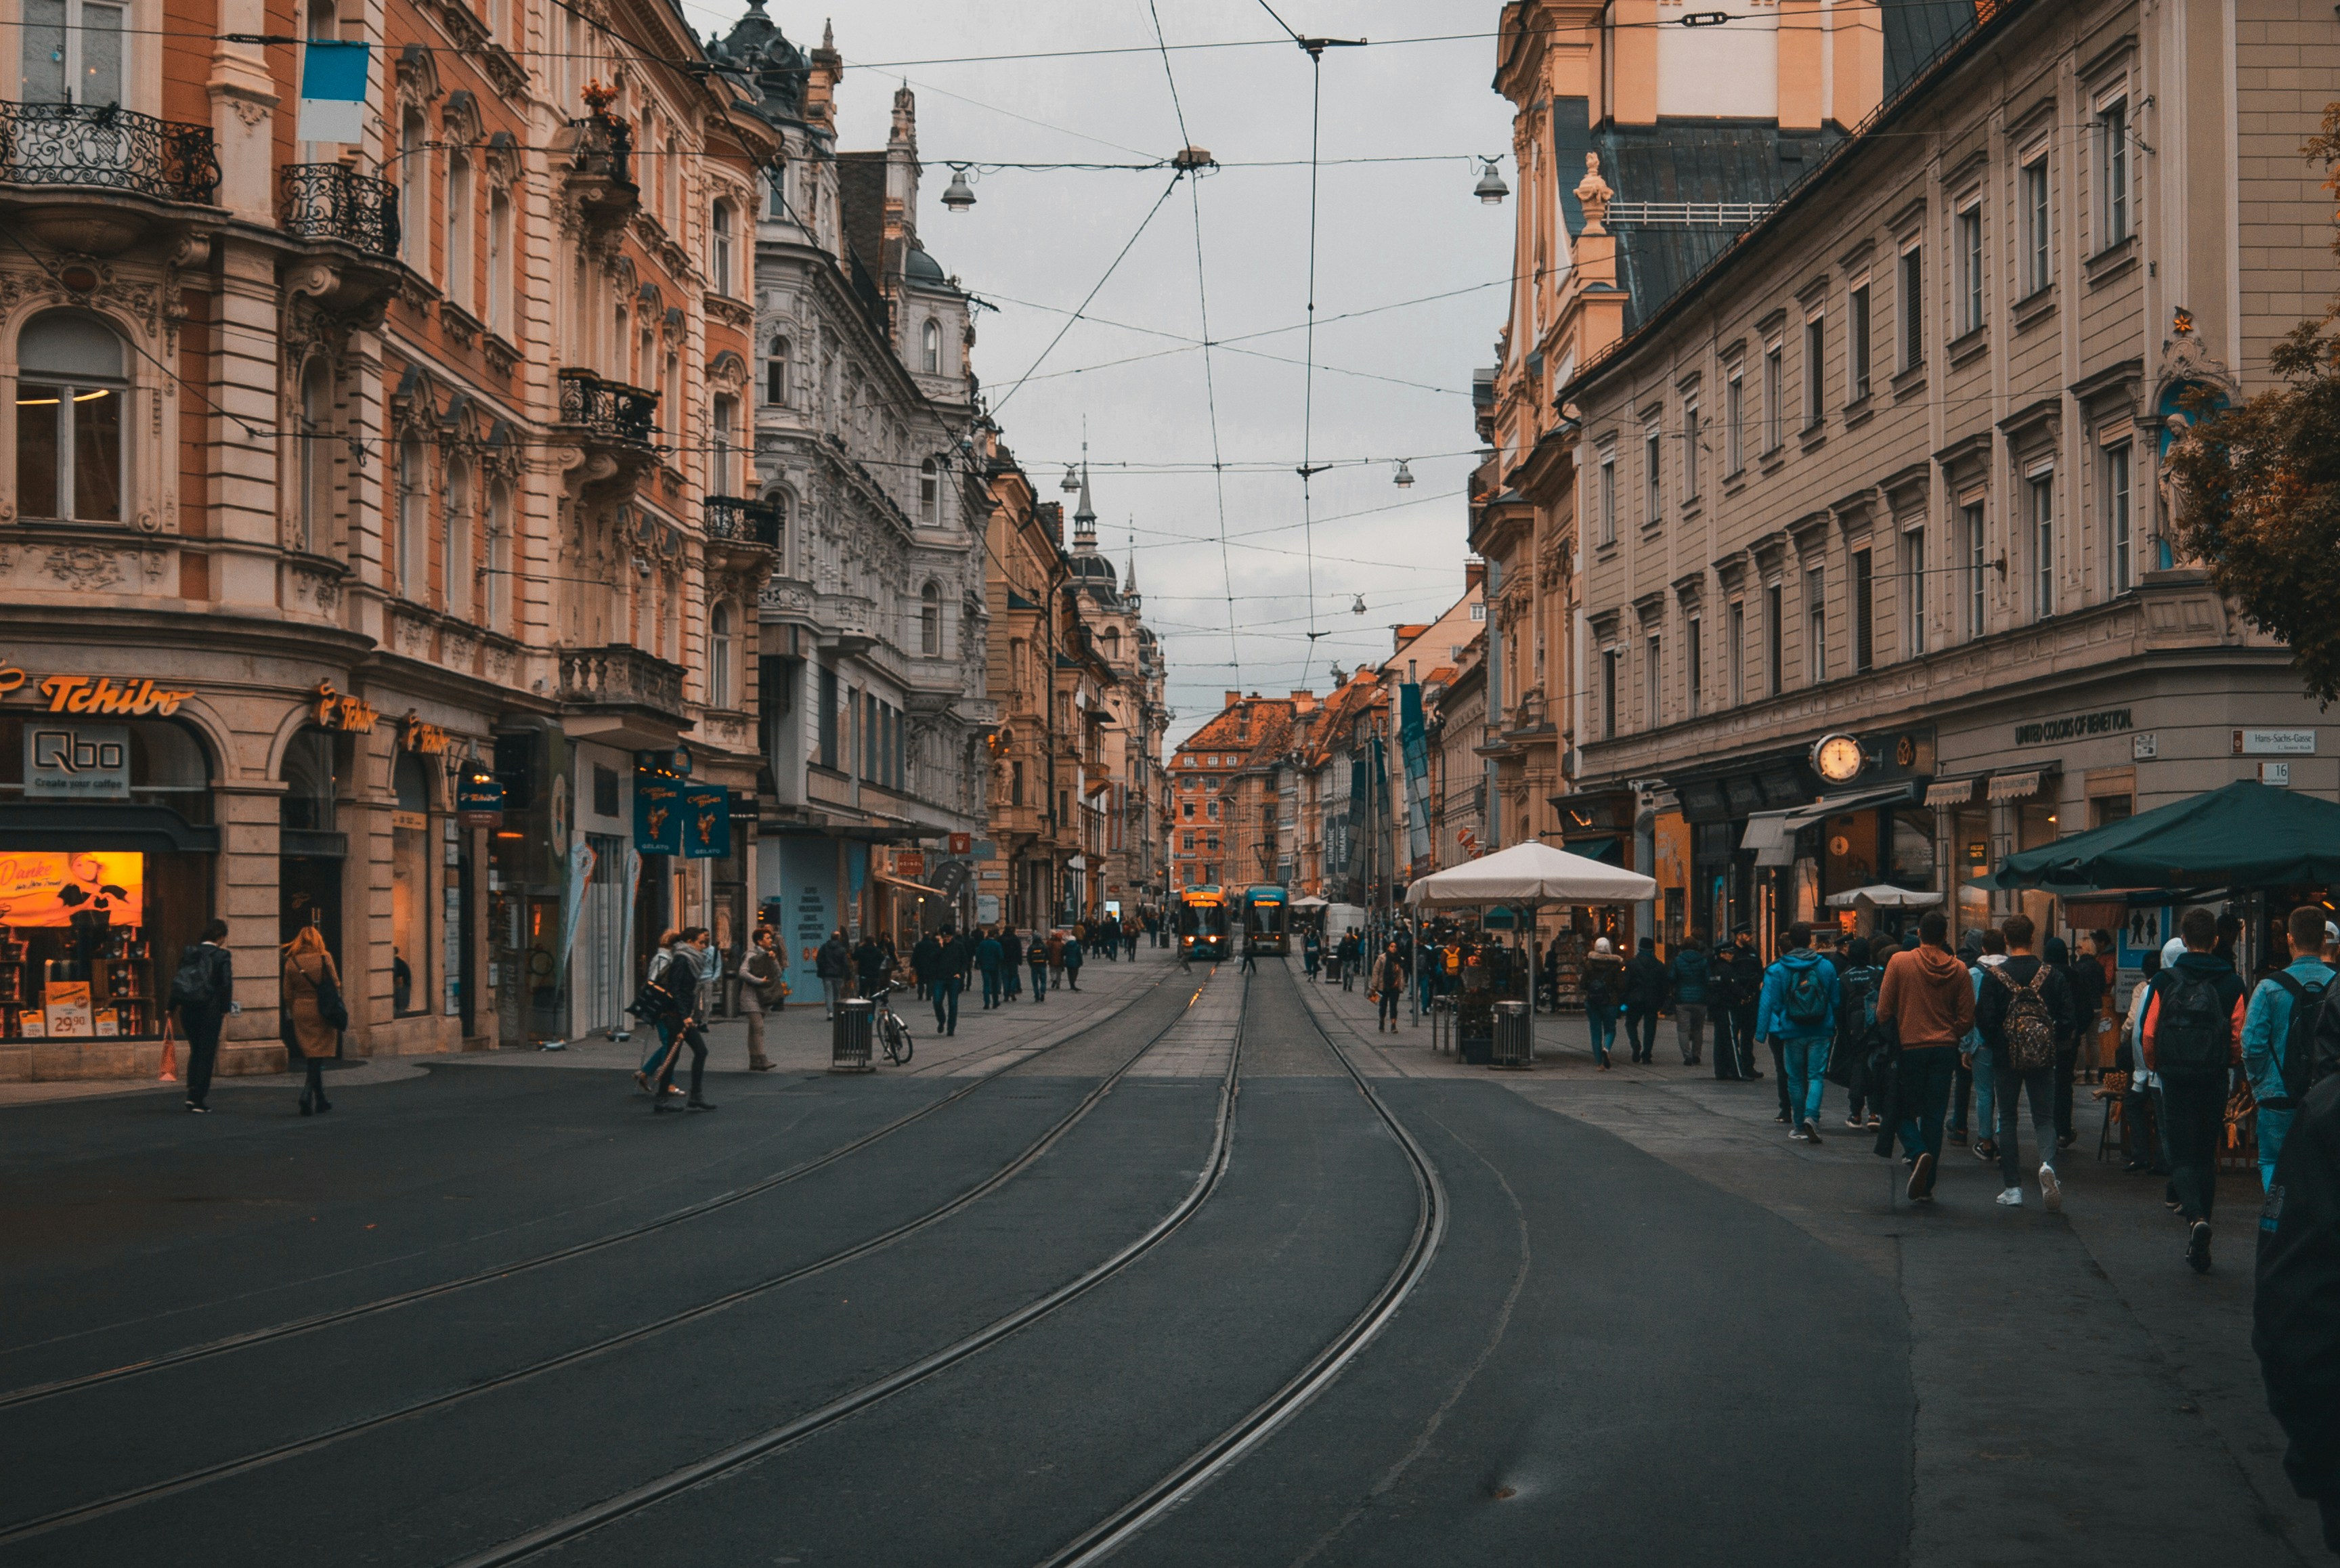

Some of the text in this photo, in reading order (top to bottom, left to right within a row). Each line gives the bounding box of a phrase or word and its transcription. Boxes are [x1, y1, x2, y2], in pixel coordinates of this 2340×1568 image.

[40, 676, 196, 716] Tchibo
[341, 697, 379, 734] Tchibo
[2015, 723, 2043, 745] UNITED
[2043, 717, 2074, 741] COLORS
[2074, 714, 2087, 735] OF
[35, 731, 123, 772] Qbo
[420, 724, 451, 755] Tchibo
[2255, 734, 2312, 743] Hans-Sachs-Gasse
[35, 778, 123, 789] Create your coffee
[2276, 764, 2287, 777] 16
[0, 859, 53, 886] Danke
